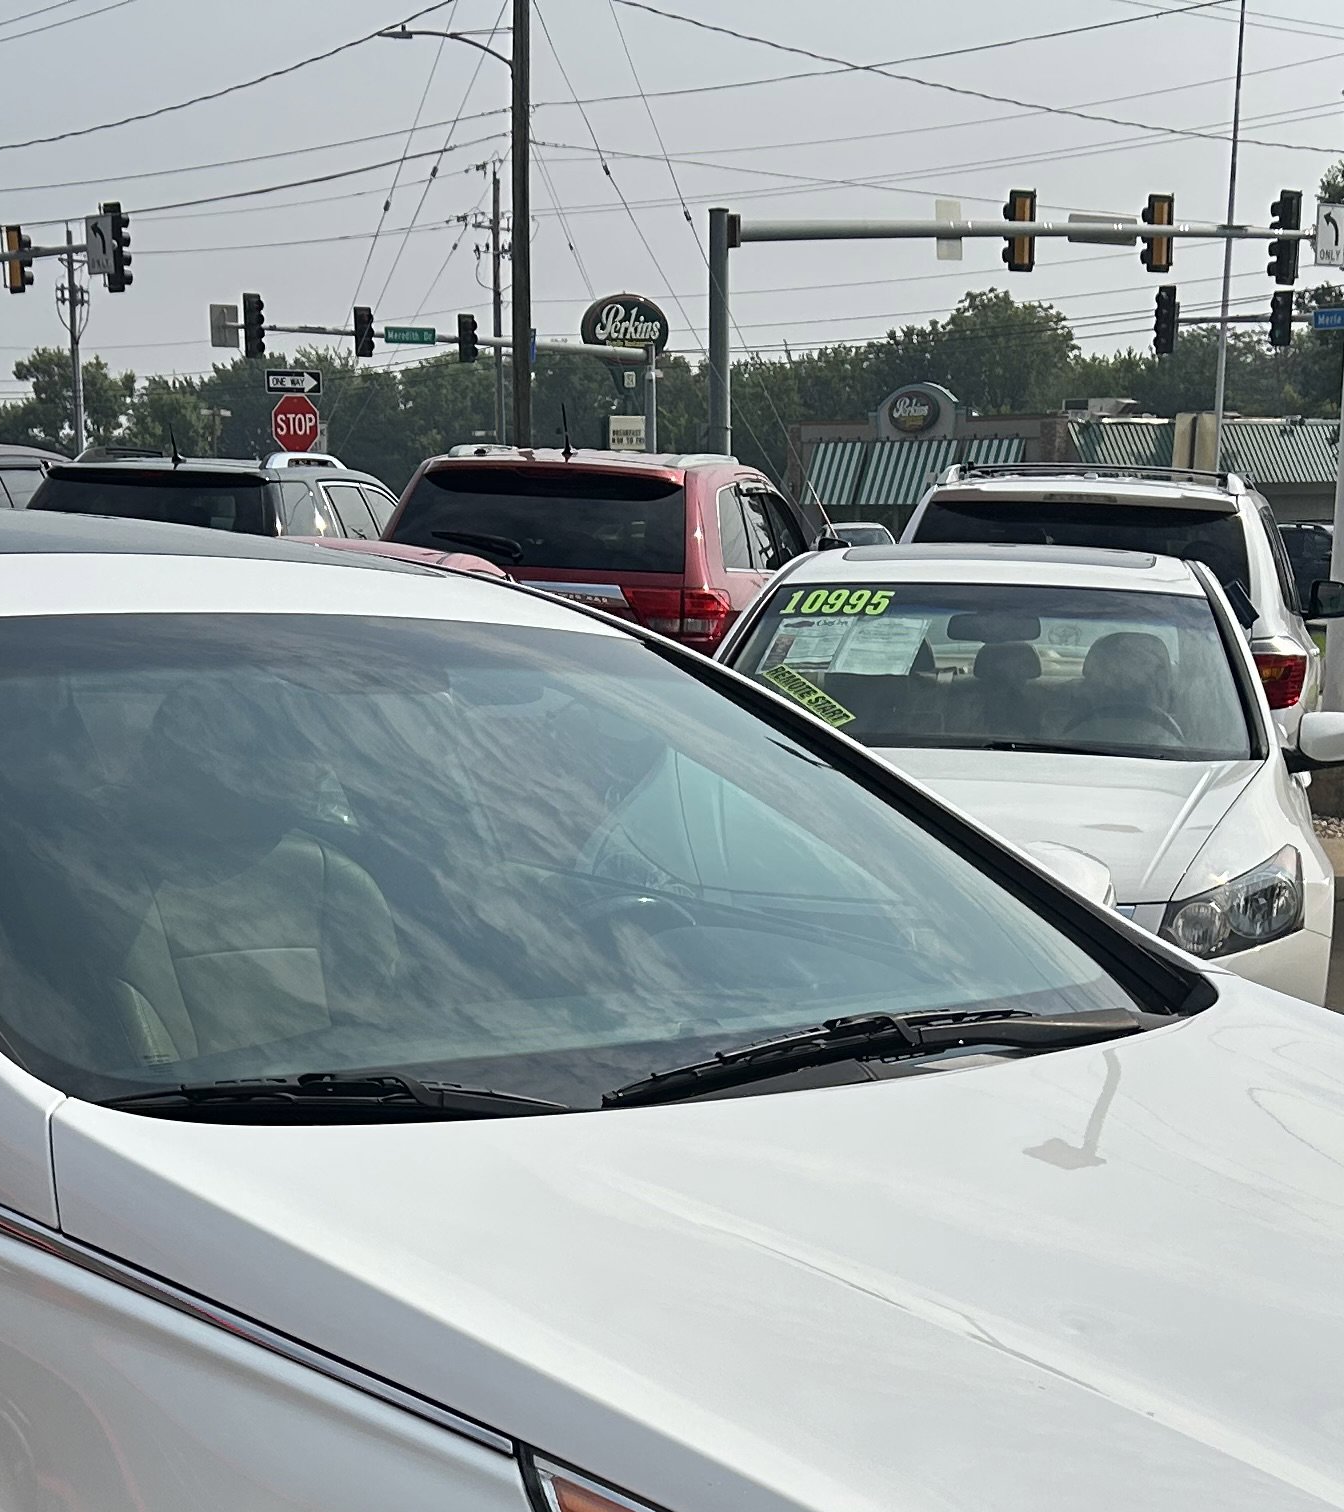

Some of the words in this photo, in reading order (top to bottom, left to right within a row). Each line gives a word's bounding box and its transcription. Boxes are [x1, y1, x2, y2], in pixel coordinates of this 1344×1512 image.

[1320, 249, 1341, 260] ONLY
[595, 303, 660, 340] Perkins
[272, 377, 286, 387] ONE
[290, 378, 305, 387] WAY
[893, 397, 929, 418] Perkins
[276, 413, 316, 436] STOP
[779, 590, 896, 616] 10995
[766, 665, 813, 701] REMOTE
[806, 691, 852, 724] START
